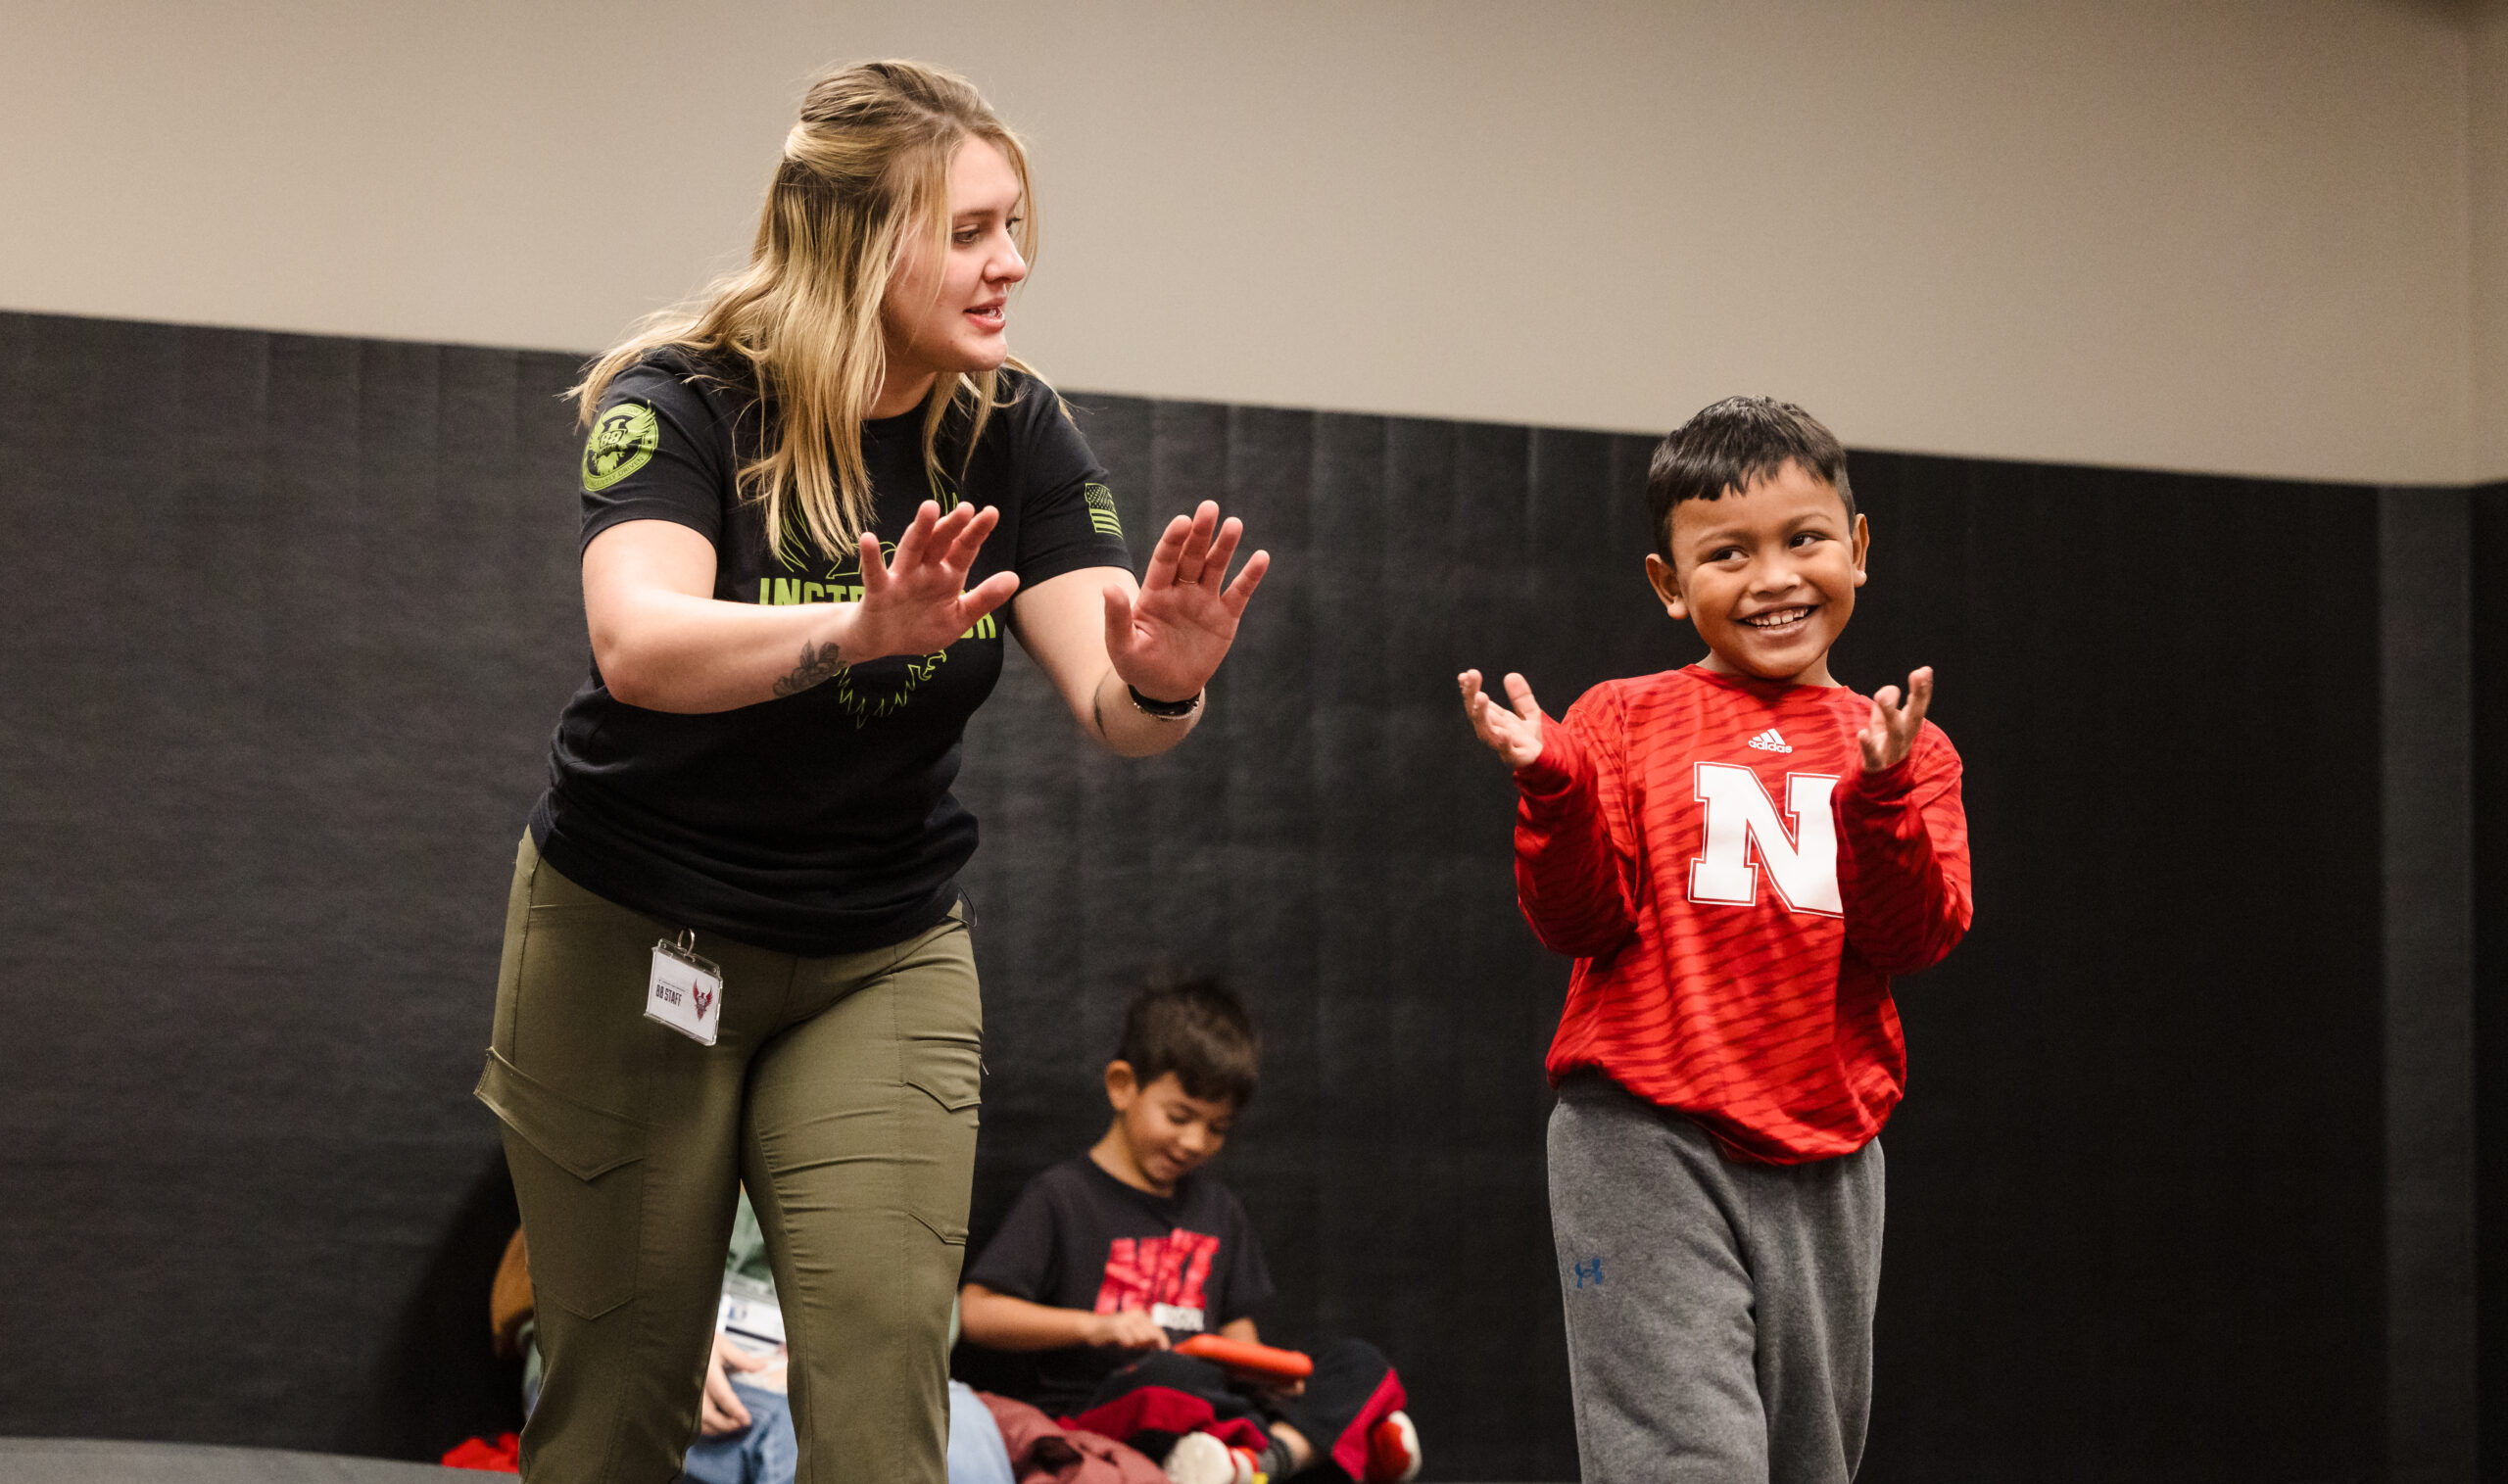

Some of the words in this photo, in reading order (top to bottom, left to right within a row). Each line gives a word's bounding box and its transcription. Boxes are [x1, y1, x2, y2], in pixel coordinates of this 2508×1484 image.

[617, 456, 645, 476] DRIVEN
[1748, 740, 1793, 753] adidas
[1688, 761, 1845, 919] N
[663, 987, 683, 1007] STAFF
